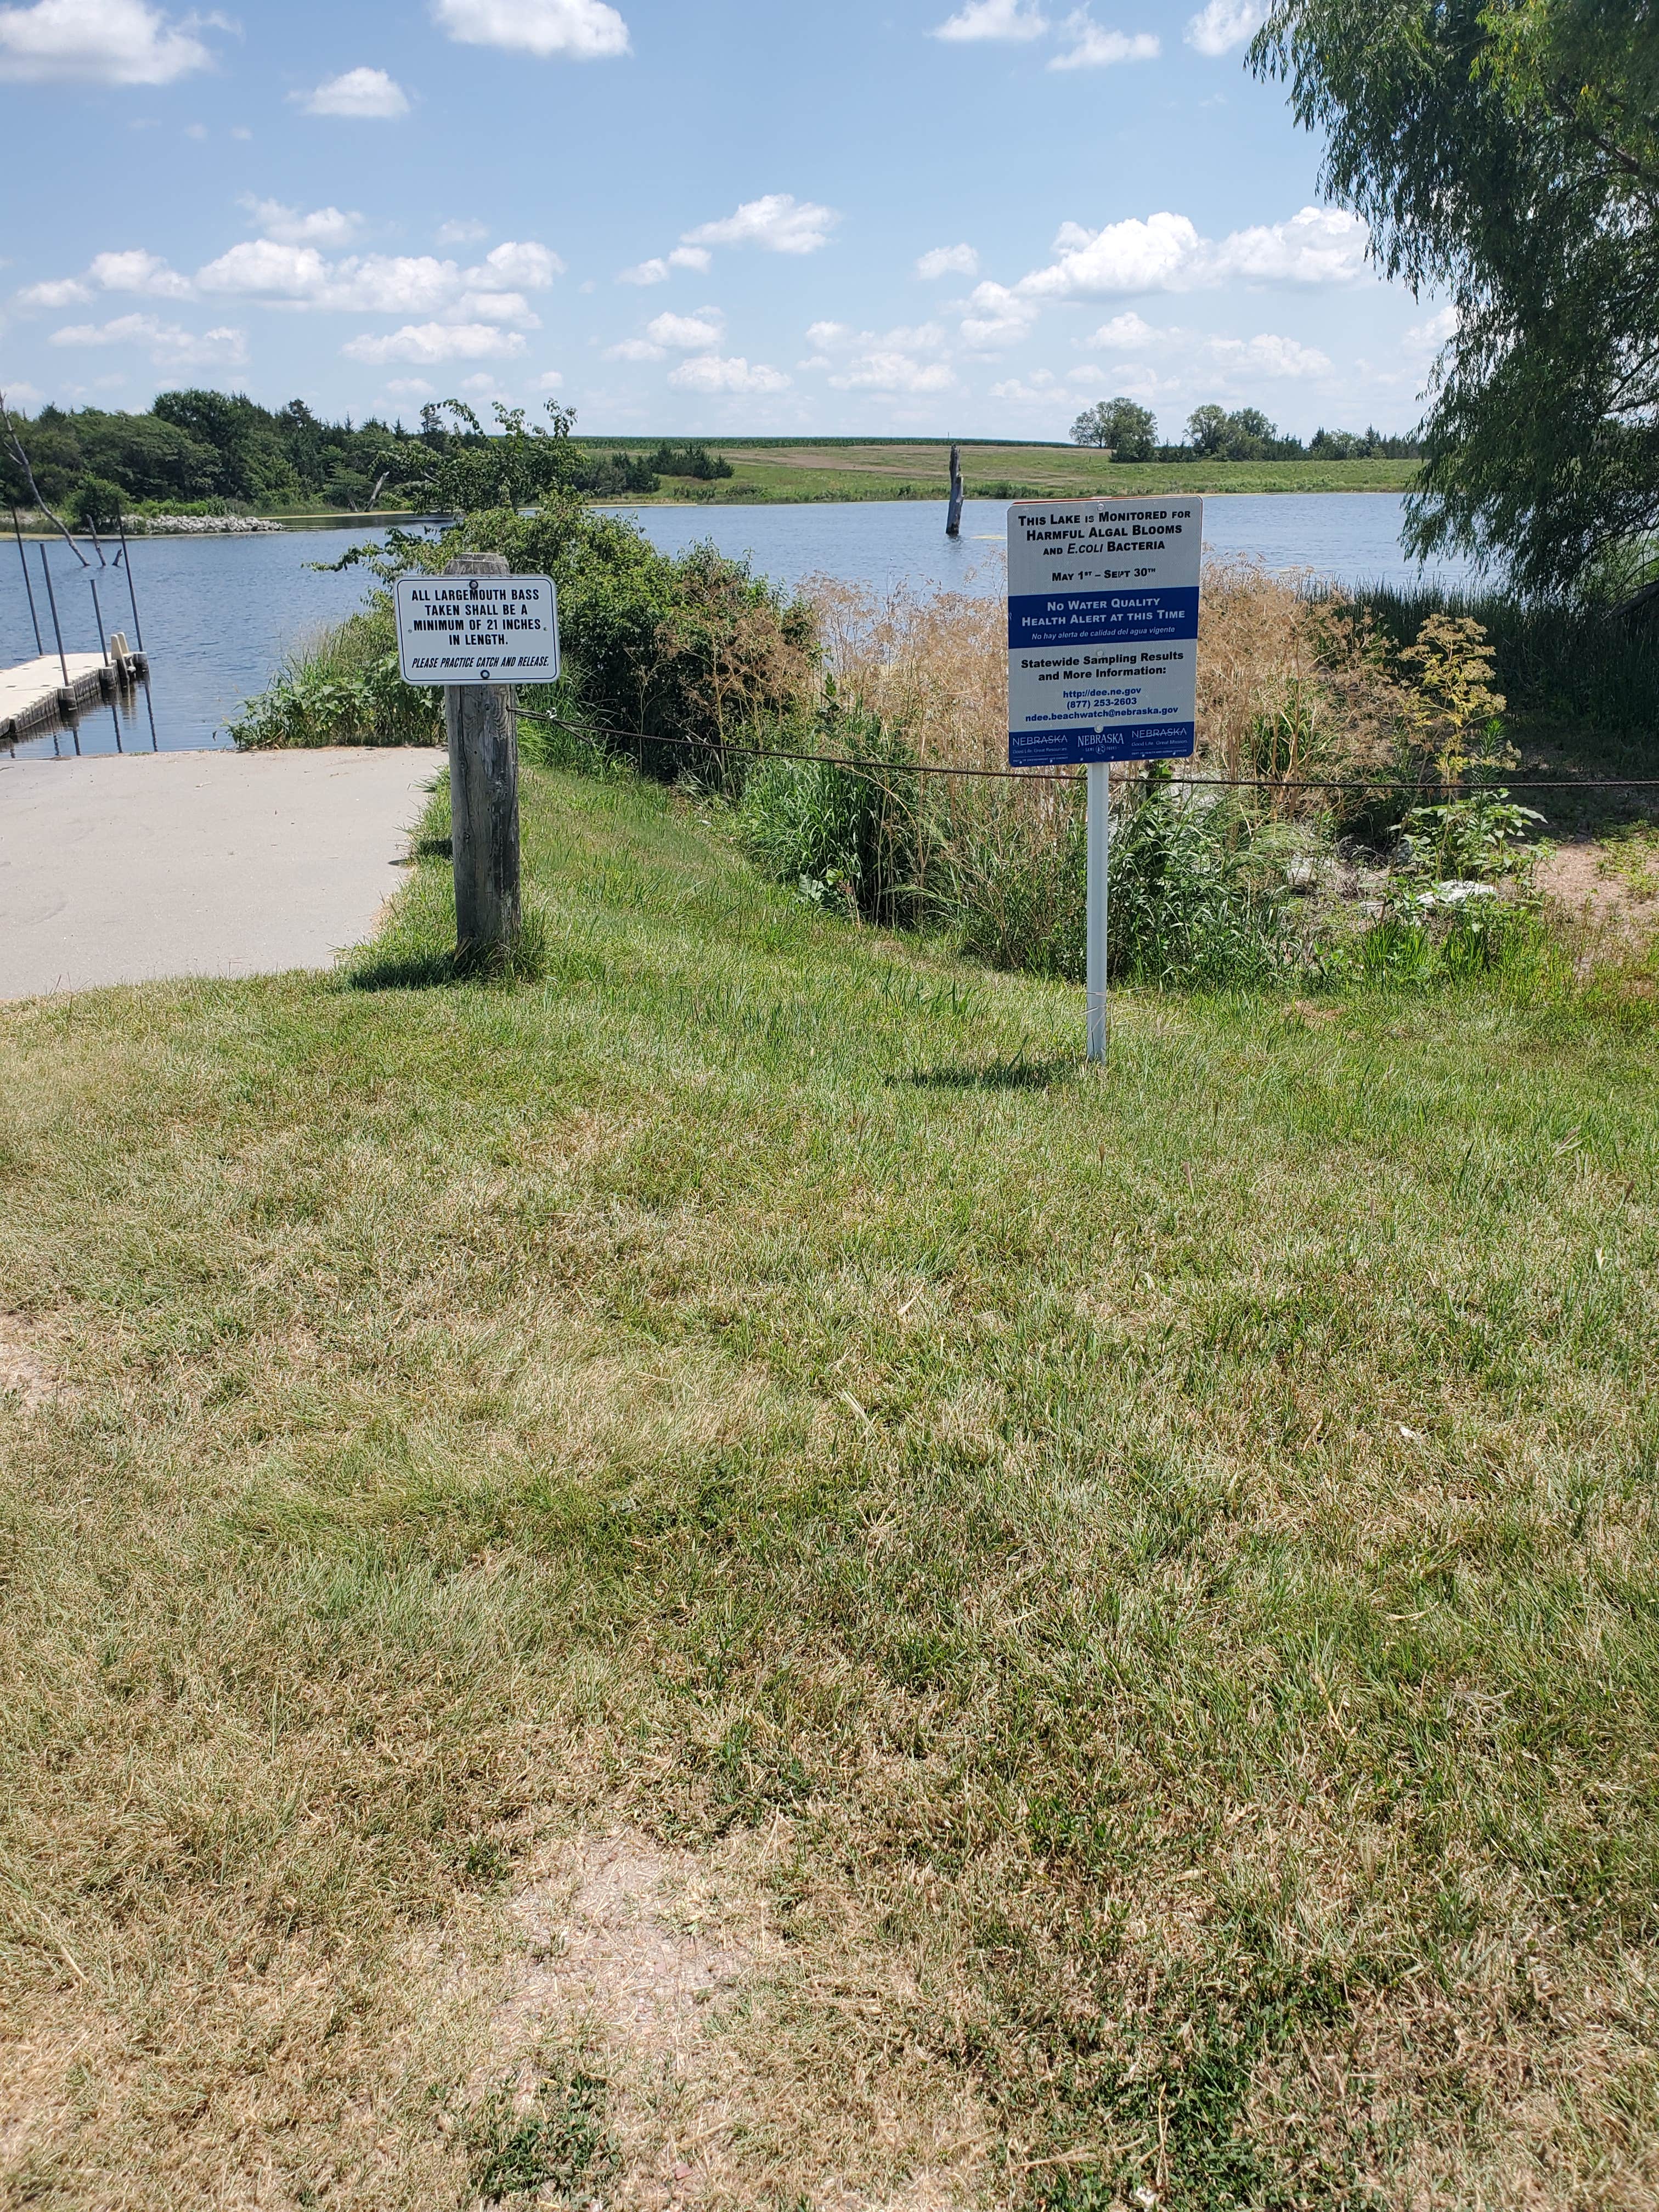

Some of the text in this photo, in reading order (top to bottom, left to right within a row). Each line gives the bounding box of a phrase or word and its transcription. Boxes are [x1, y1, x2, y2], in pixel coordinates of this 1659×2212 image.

[1018, 516, 1046, 526] THIS
[1050, 514, 1080, 524] LAKE
[1099, 511, 1167, 522] MONITORED
[1026, 524, 1182, 541] HARMFUL ALGAL BLOOMS
[1067, 543, 1103, 554] E.COLI
[1108, 541, 1165, 552] BACTERIA
[1052, 573, 1074, 582] MAY
[412, 589, 539, 601] ALL LARGEMOUTH BASS
[1068, 601, 1107, 610] WATER
[1111, 598, 1161, 608] QUALITY
[425, 605, 528, 616] TAKEN SHALL BE A
[1022, 617, 1066, 627] HEALTH
[1070, 614, 1107, 624] ALERT
[1127, 612, 1153, 620] THIS
[1157, 610, 1186, 619] TIME
[414, 619, 541, 631] MINIMUM OF 21 INCHES
[1091, 629, 1115, 637] calidad
[1130, 628, 1147, 636] agua
[1149, 626, 1175, 634] vigente
[449, 634, 508, 645] IN LENGTH.
[412, 656, 549, 668] PLEASE PRACTICE CATCH AND RELEASE.
[1021, 651, 1184, 668] Statewide Sampling Results
[1039, 667, 1166, 681] and More Information:
[1063, 687, 1141, 698] http://dee.ne.gov
[1067, 698, 1137, 709] (877) 253-2603
[1025, 707, 1178, 722] ndee.beachwatch@nebraska.gov
[1132, 728, 1187, 738] NEBRASKA
[1013, 735, 1068, 746] NEBRASKA
[1078, 733, 1124, 747] NEBRASKA
